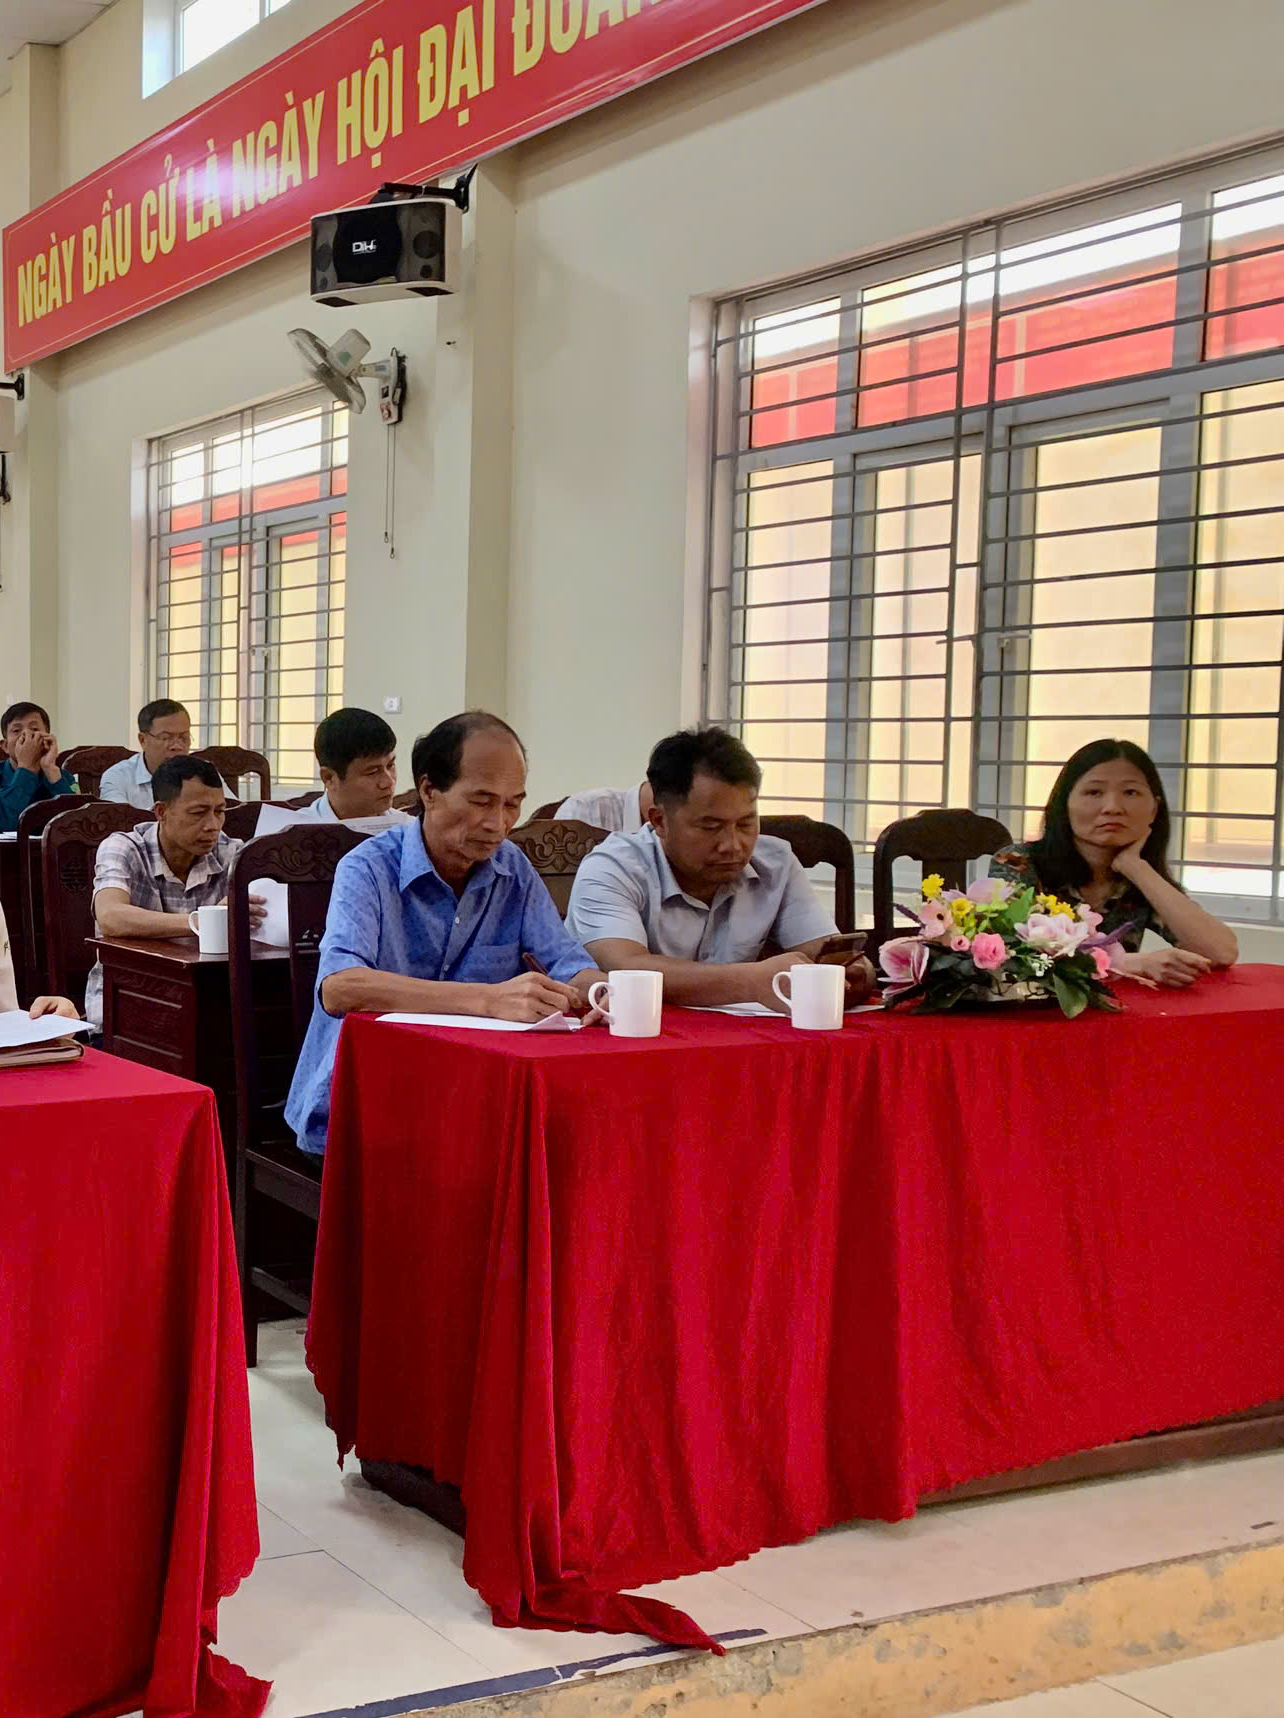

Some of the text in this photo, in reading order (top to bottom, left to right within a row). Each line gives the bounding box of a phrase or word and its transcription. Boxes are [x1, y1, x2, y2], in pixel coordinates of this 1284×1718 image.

[18, 232, 76, 329] NGÀY
[83, 188, 132, 295] BẦU
[140, 153, 180, 264] CỬ
[186, 138, 223, 242] LÀ
[232, 90, 325, 219] NGÀY
[337, 37, 404, 169] HỘI
[417, 0, 495, 127] ĐẠI
